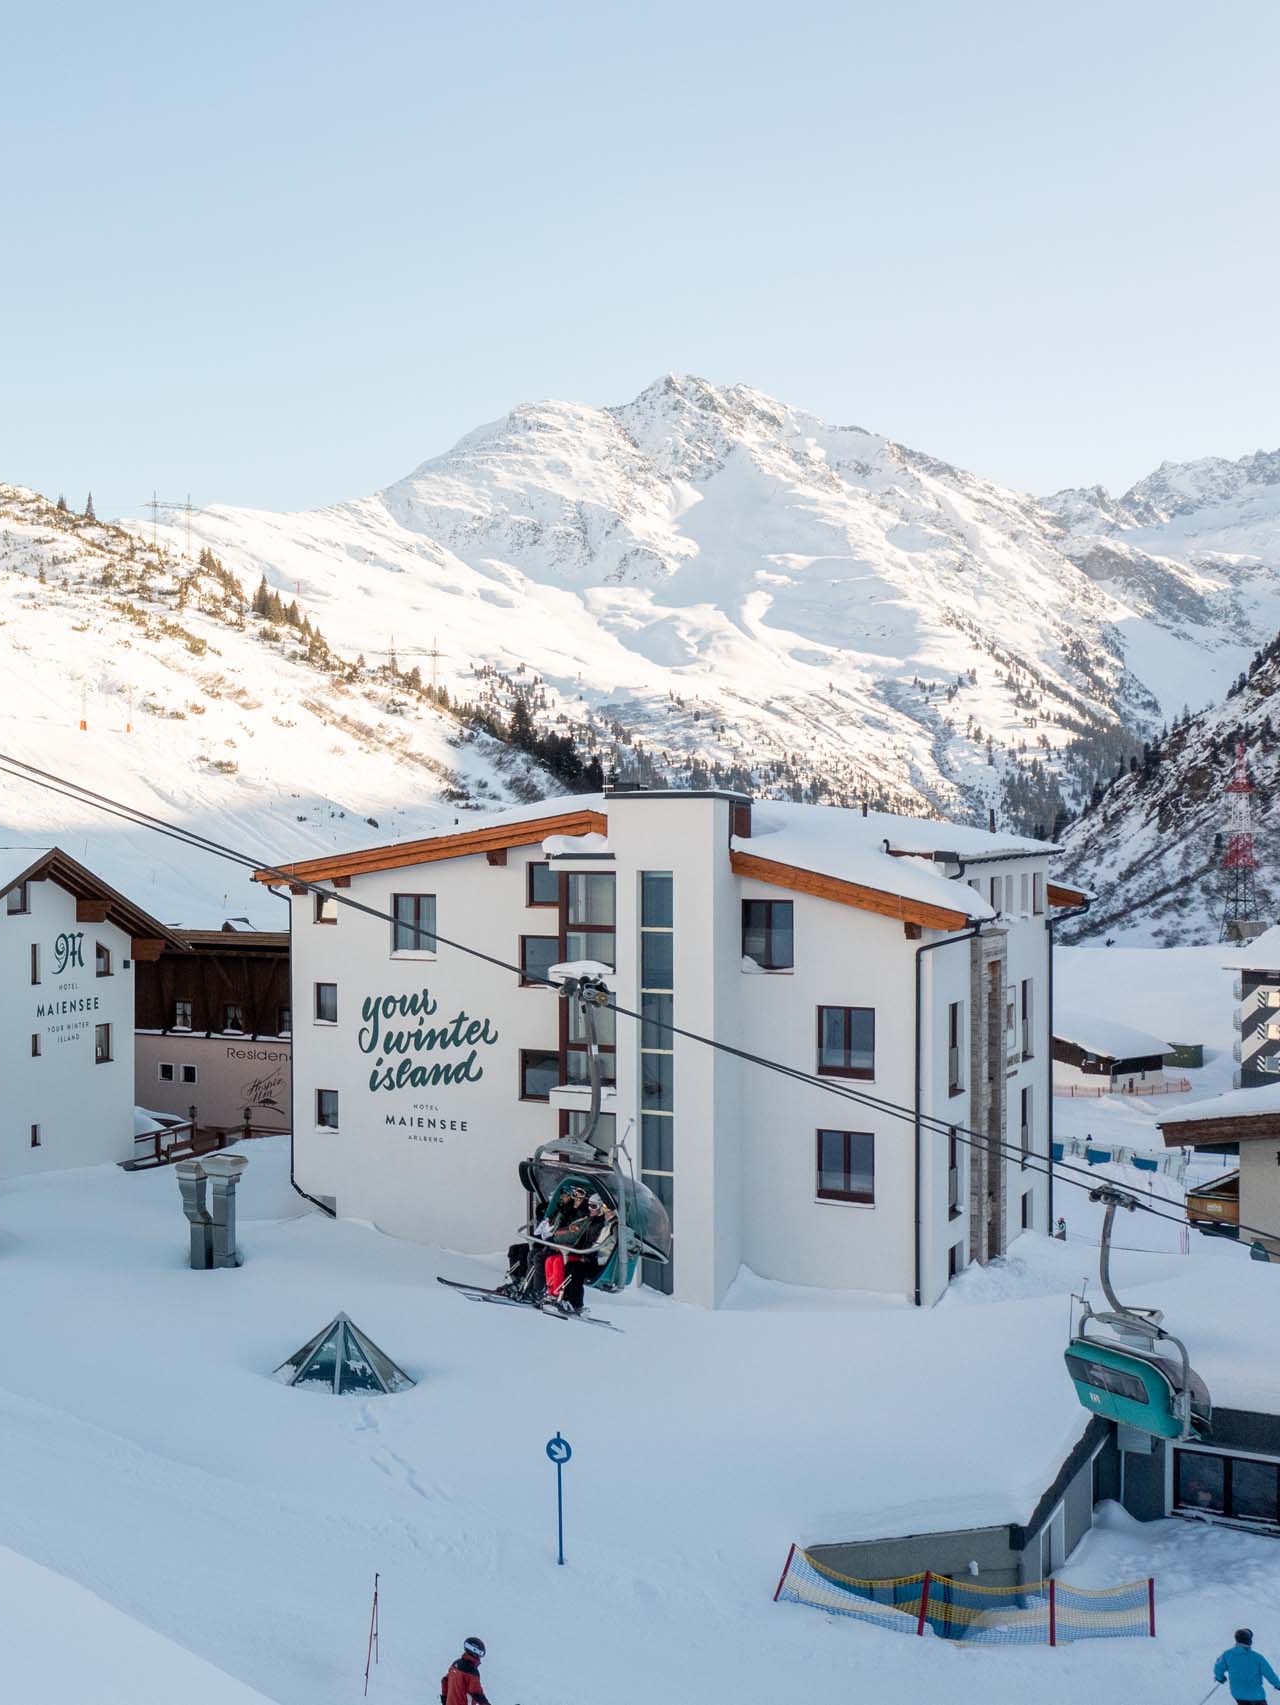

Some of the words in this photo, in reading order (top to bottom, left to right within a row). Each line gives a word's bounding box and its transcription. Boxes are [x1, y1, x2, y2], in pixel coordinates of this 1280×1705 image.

[58, 983, 79, 991] HOTEL
[36, 996, 101, 1018] MAIENSEE
[47, 1024, 64, 1033] YOUR
[67, 1021, 89, 1031] WINTER
[358, 988, 438, 1053] your
[57, 1033, 80, 1044] ISLAND
[383, 1010, 499, 1055] winter
[226, 1047, 291, 1062] Residen
[369, 1049, 484, 1092] island
[413, 1103, 440, 1111] HOTEL
[385, 1114, 469, 1131] MAIENSEE
